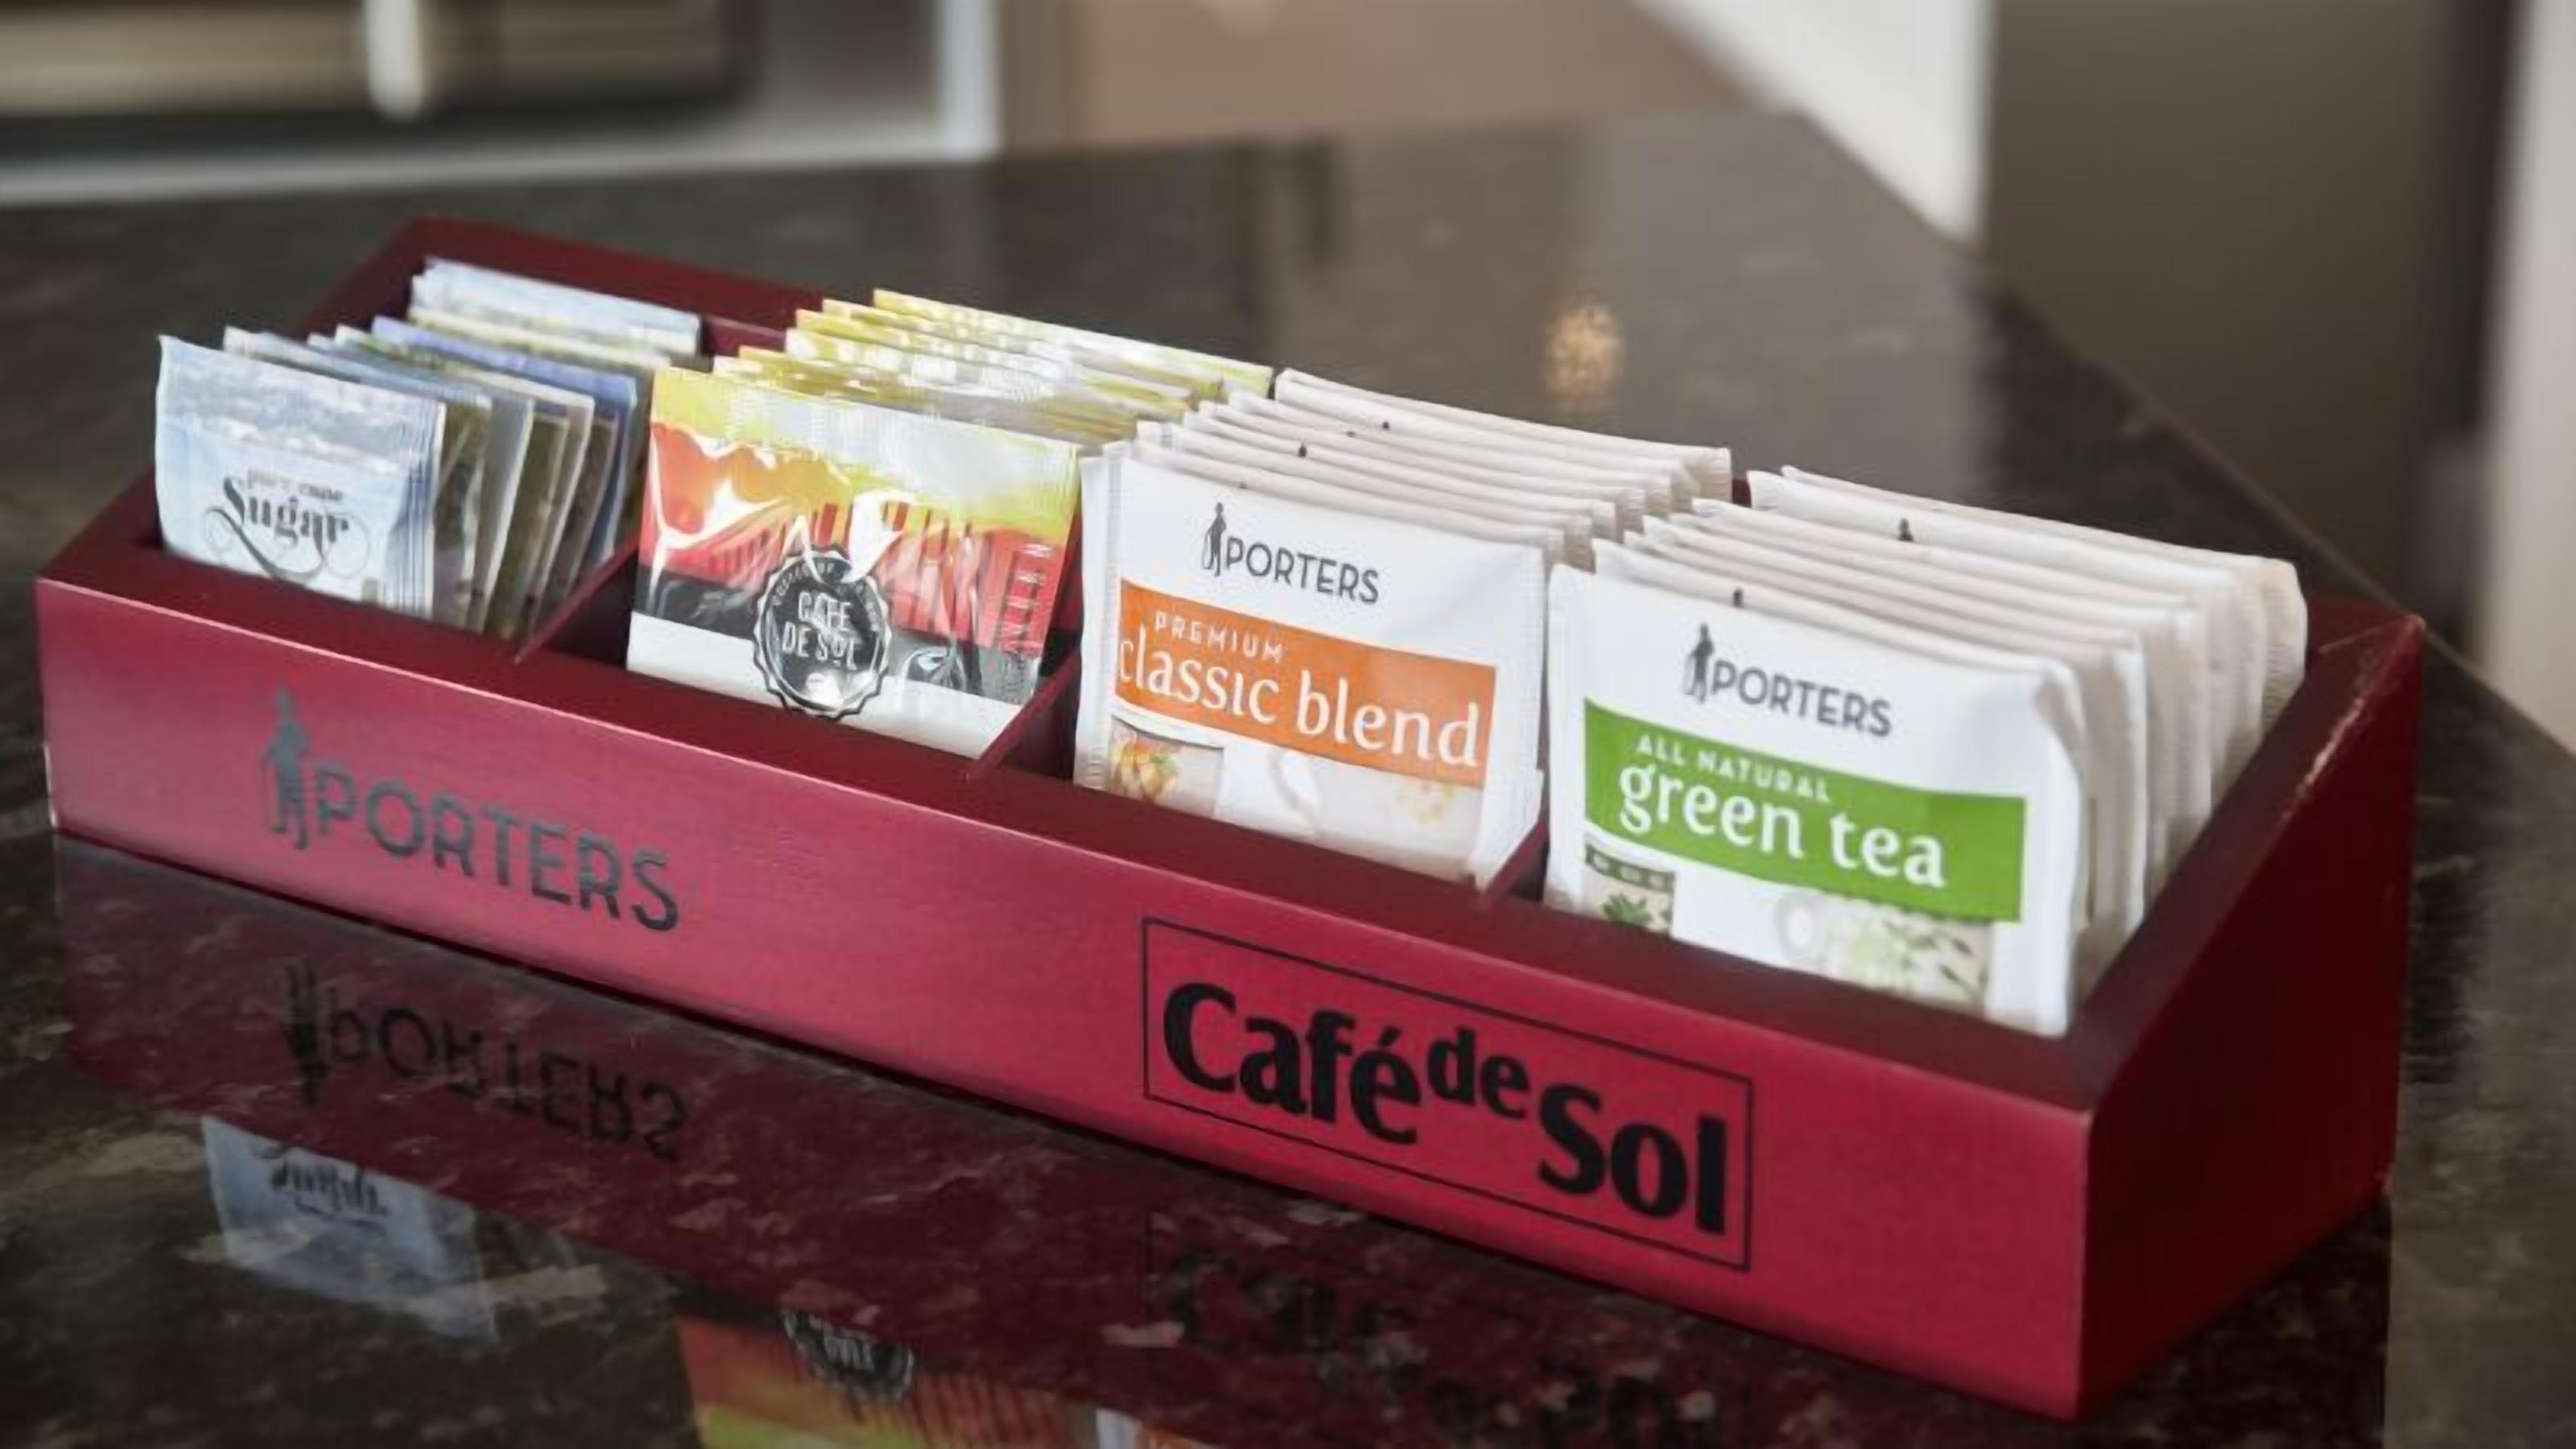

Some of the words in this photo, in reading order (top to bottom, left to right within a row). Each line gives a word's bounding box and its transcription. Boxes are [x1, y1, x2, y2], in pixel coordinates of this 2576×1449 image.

[204, 476, 351, 578] Sugar
[1226, 535, 1381, 605] PORTERS
[782, 621, 811, 658] DE
[815, 633, 857, 671] SOL
[1153, 610, 1285, 664] PREMIUM
[1118, 625, 1280, 724] classic
[1297, 669, 1481, 768] blend
[1710, 657, 1893, 738] PORTERS
[1636, 733, 1687, 766] ALL
[1697, 742, 1833, 804] NATURAL
[314, 762, 679, 932] PORTERS
[1619, 762, 1805, 860] green
[1830, 811, 1946, 889] tea
[1162, 982, 1422, 1145] Café
[1426, 1026, 1531, 1120] de
[1538, 1083, 1728, 1236] Sol
